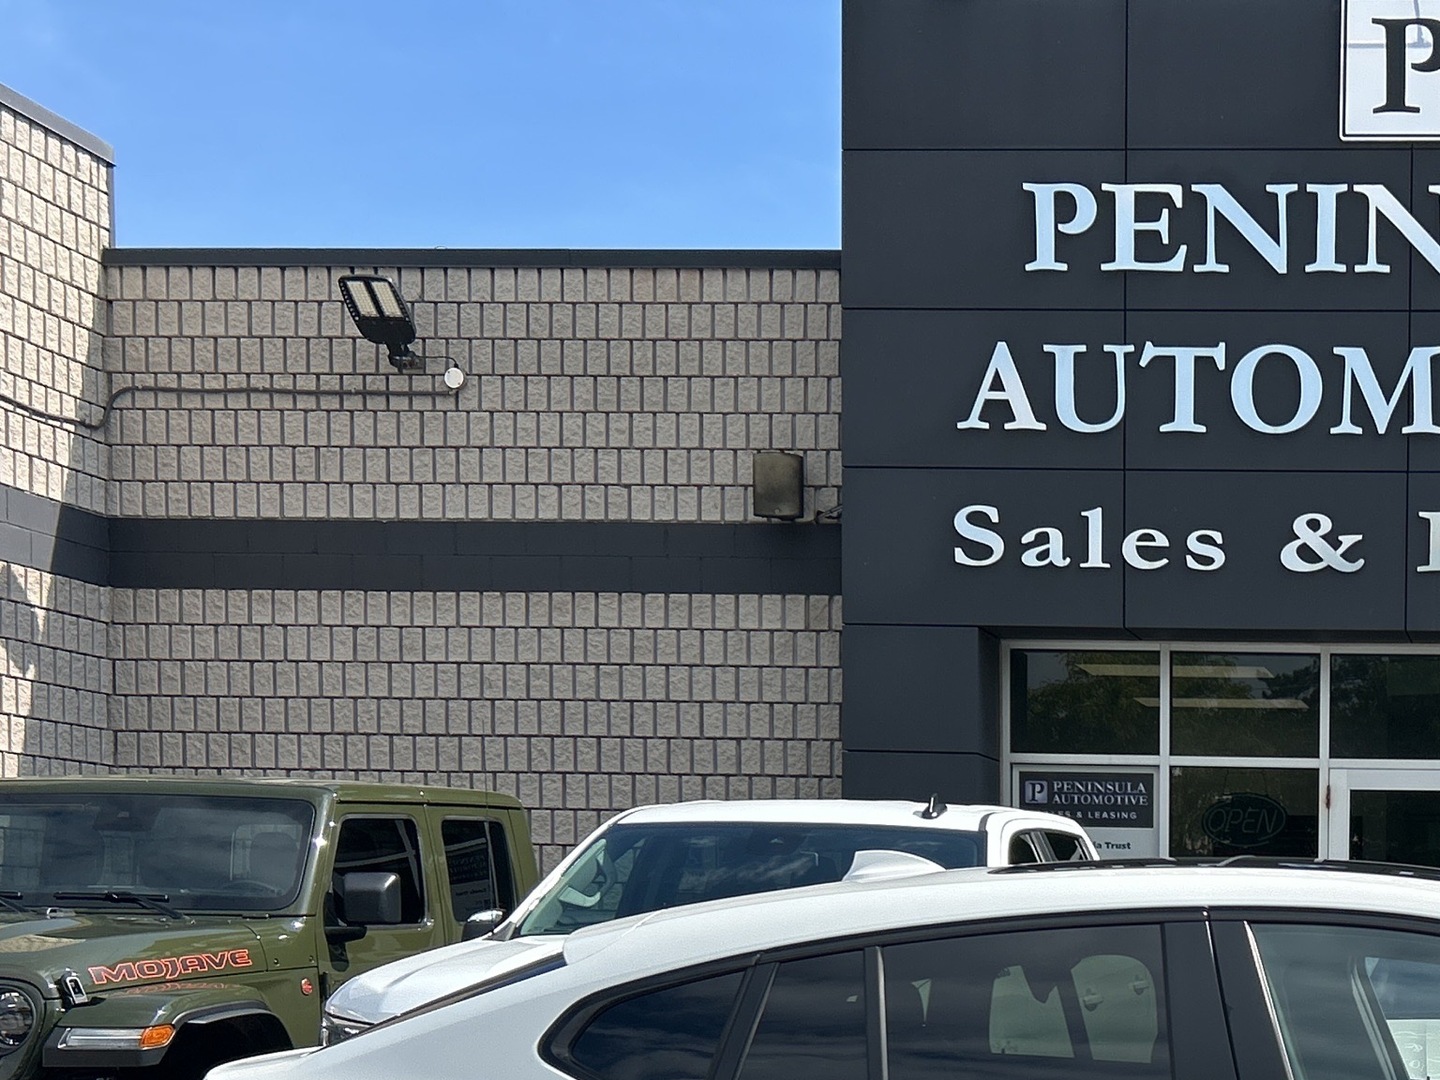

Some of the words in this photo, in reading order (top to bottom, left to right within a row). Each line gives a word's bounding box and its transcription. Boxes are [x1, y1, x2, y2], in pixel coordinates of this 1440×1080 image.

[953, 507, 1225, 572] Sales
[1280, 512, 1366, 573] &
[1030, 783, 1045, 802] P
[1053, 781, 1147, 794] PENINSULA
[1052, 794, 1149, 806] AUTOMOTIVE
[1088, 811, 1138, 820] LEASING
[1208, 808, 1278, 834] OPEN
[1104, 841, 1131, 850] Trust
[88, 949, 253, 985] MOJAVE
